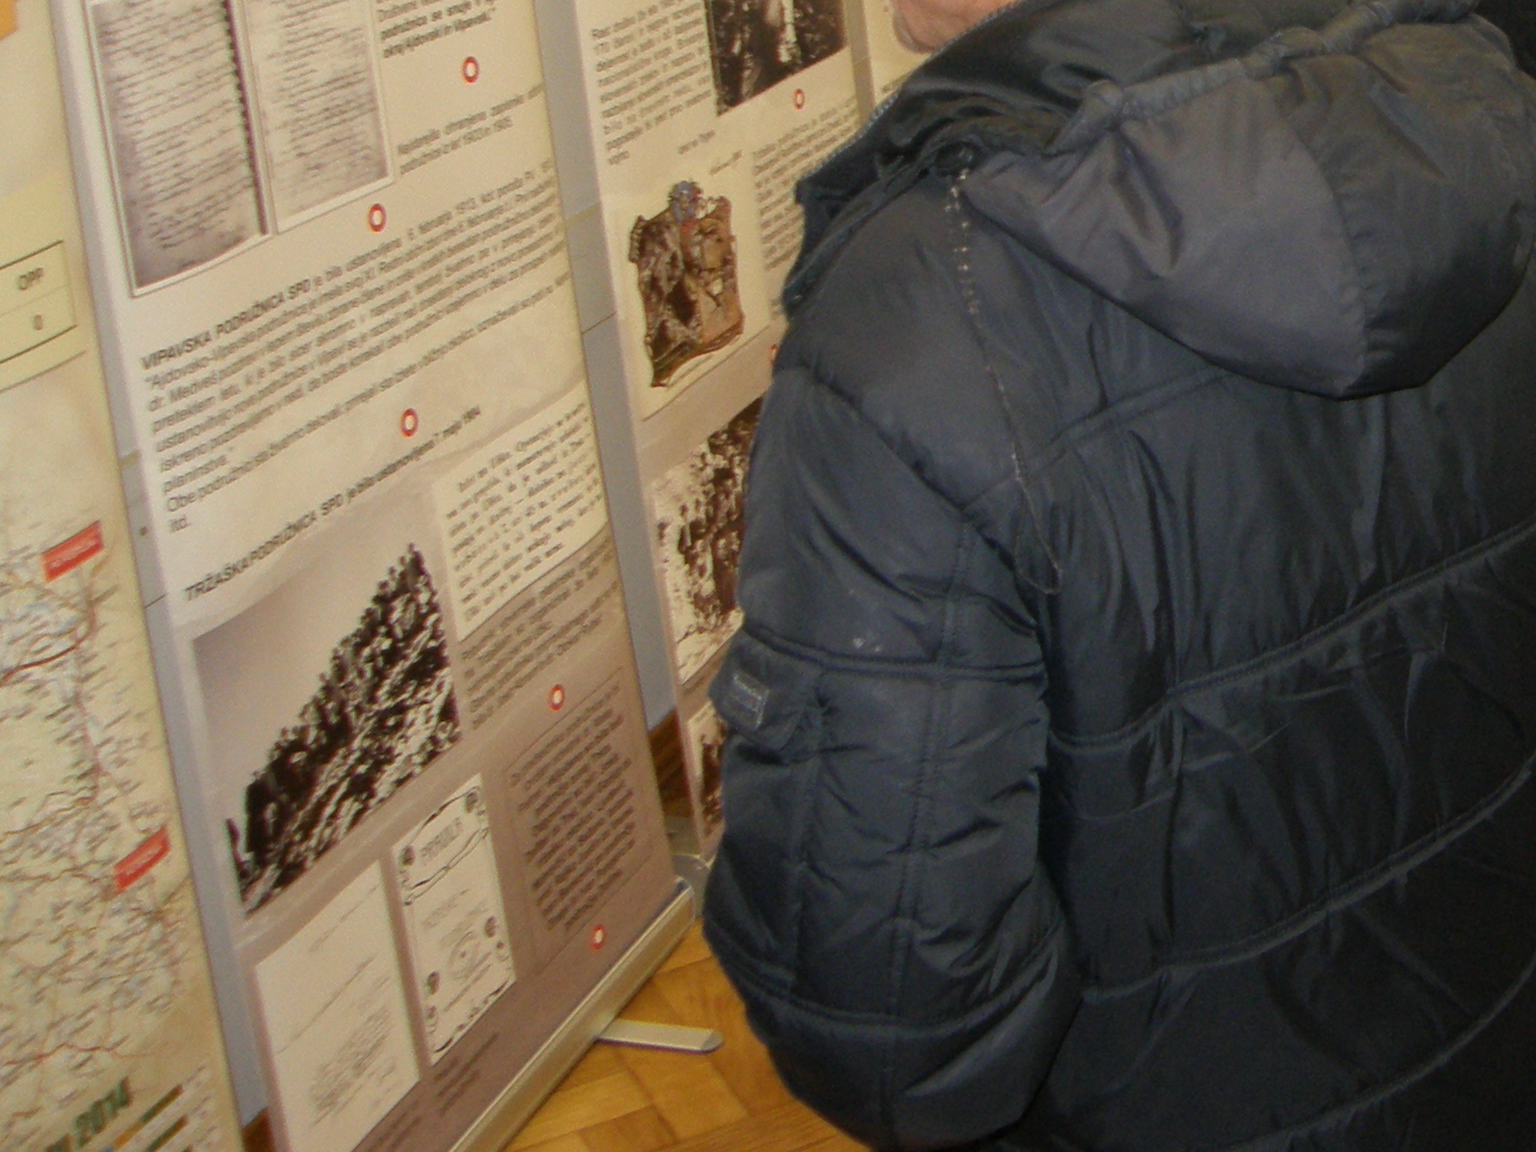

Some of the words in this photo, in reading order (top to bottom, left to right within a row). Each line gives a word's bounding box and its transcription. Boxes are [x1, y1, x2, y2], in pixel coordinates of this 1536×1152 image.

[142, 332, 211, 369] VIPAVSKA
[216, 292, 284, 338] PODRUŽNICA
[288, 279, 310, 299] SPD
[167, 493, 195, 512] Obe
[185, 556, 249, 600] TRŽAŠKA
[251, 509, 317, 564] PODRUŽNICA
[321, 493, 344, 517] SPD
